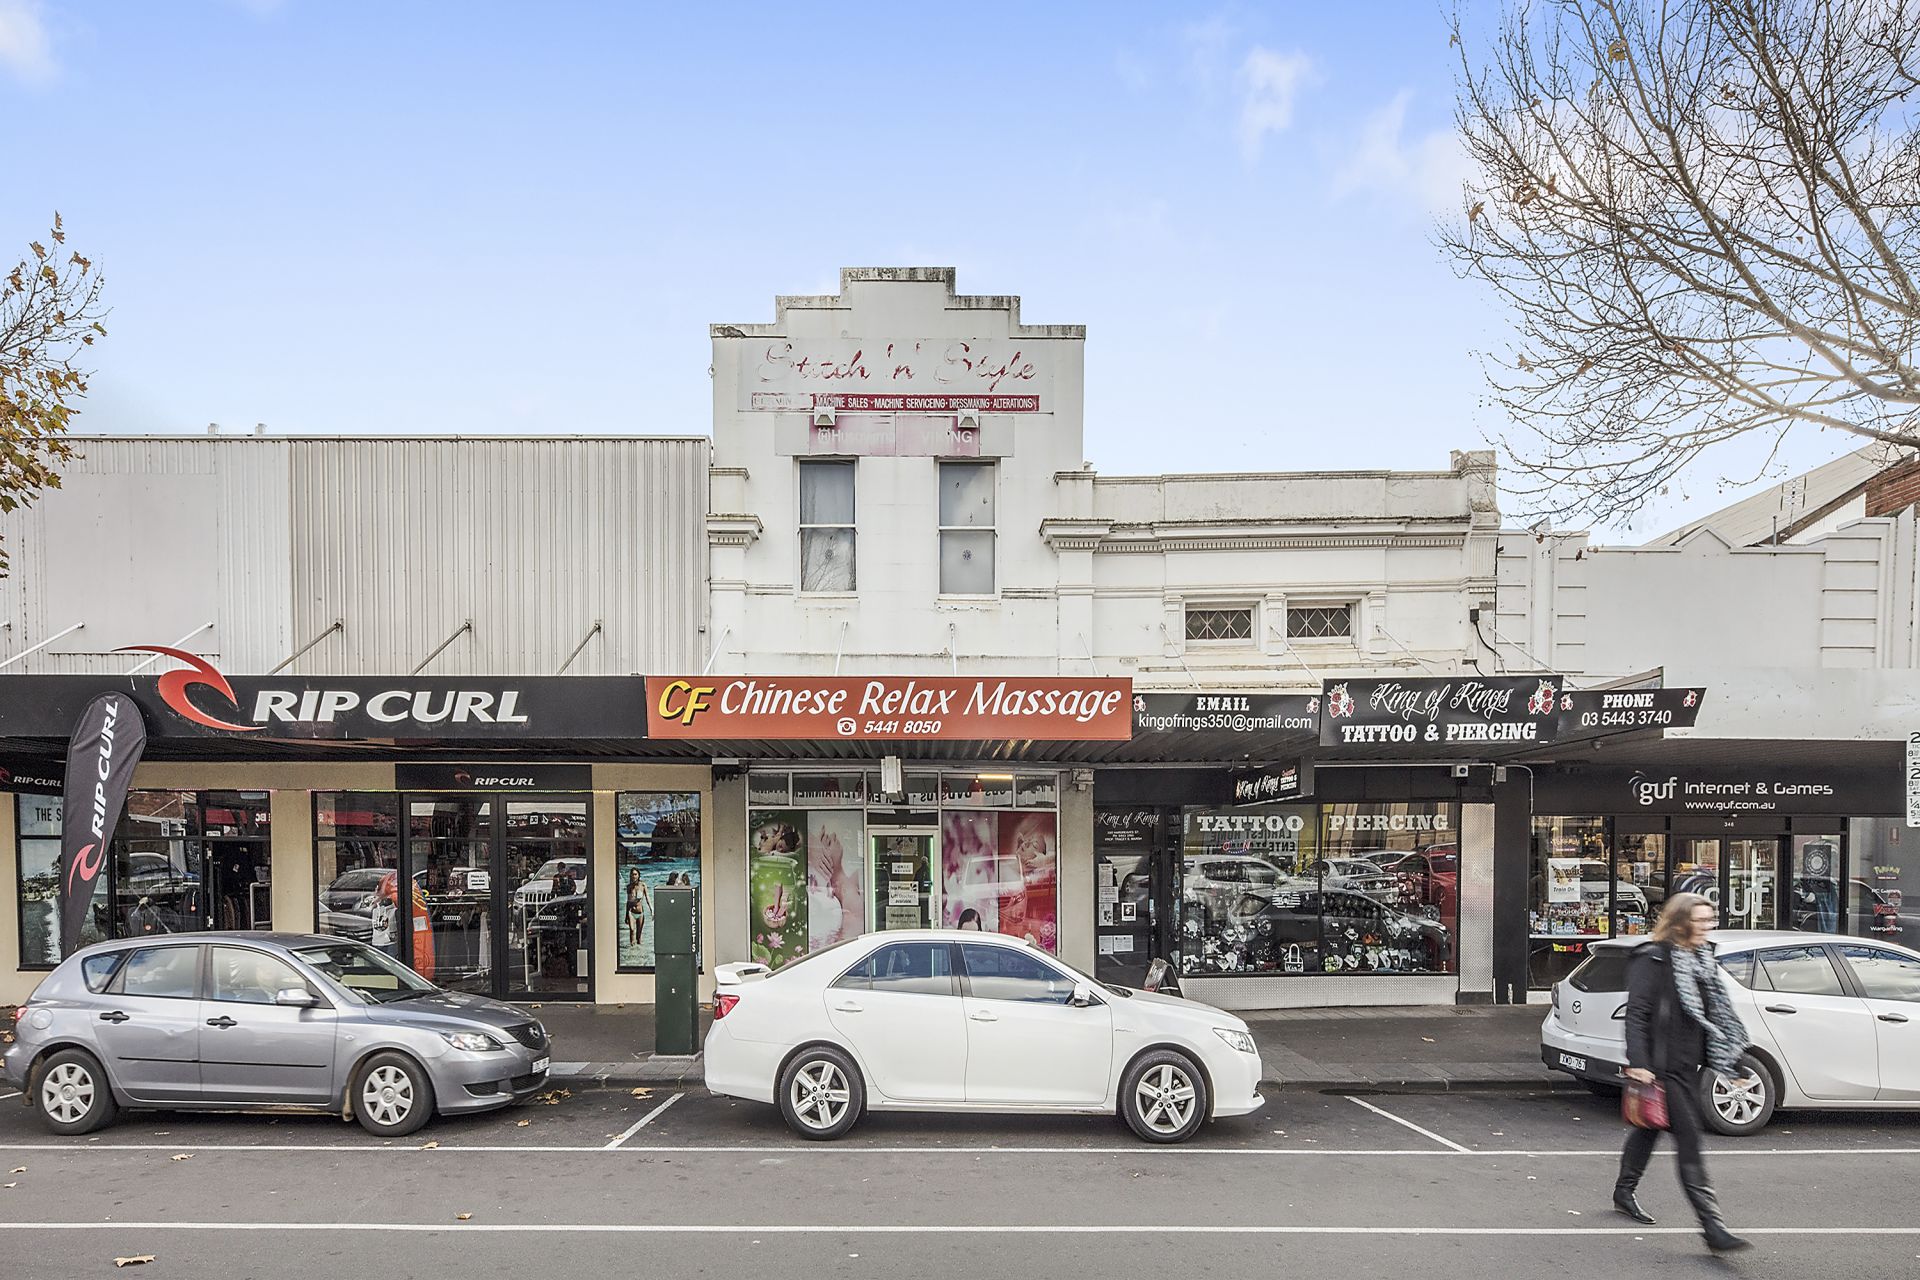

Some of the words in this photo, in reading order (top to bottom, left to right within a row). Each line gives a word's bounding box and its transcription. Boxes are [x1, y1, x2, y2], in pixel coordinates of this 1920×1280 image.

[848, 398, 869, 408] SALES
[874, 398, 904, 409] MACHINE
[949, 398, 991, 408] DRESSMAKING
[992, 398, 1033, 408] ALTERATIONS
[252, 690, 361, 723] RIP
[366, 690, 529, 723] CURL
[658, 680, 717, 725] CF
[720, 680, 848, 716] Chinese
[857, 680, 958, 716] Relax
[963, 681, 1122, 722] Massage
[1196, 697, 1250, 712] EMAIL
[1369, 682, 1426, 721] King
[1424, 683, 1451, 721] of
[1450, 681, 1515, 720] Rings
[1602, 693, 1655, 709] PHONE
[864, 720, 899, 734] 5441
[903, 720, 942, 734] 8050
[1138, 713, 1313, 732] kingofrings350@gmail.com
[1581, 711, 1599, 727] 03
[1601, 710, 1635, 726] 5443
[1637, 710, 1672, 725] 3740
[98, 701, 118, 782] CURL
[1341, 724, 1417, 743] TATTOO
[1424, 723, 1440, 742] &
[1445, 722, 1537, 741] PIERCING
[13, 775, 34, 784] RIP
[34, 777, 63, 787] CURL
[474, 777, 499, 786] RIP
[498, 777, 535, 786] CURL
[1639, 776, 1678, 805] guf
[1684, 782, 1751, 795] Internet
[1755, 782, 1769, 795] &
[1773, 782, 1834, 795] Games
[35, 807, 52, 822] THE
[56, 807, 62, 822] S
[92, 782, 107, 840] RIP
[1685, 800, 1776, 811] www.guf.com.au
[1098, 812, 1123, 829] King
[1122, 812, 1133, 829] of
[1134, 811, 1160, 828] Rings
[1196, 815, 1305, 832] TATTOO
[1328, 814, 1449, 831] PIERCING
